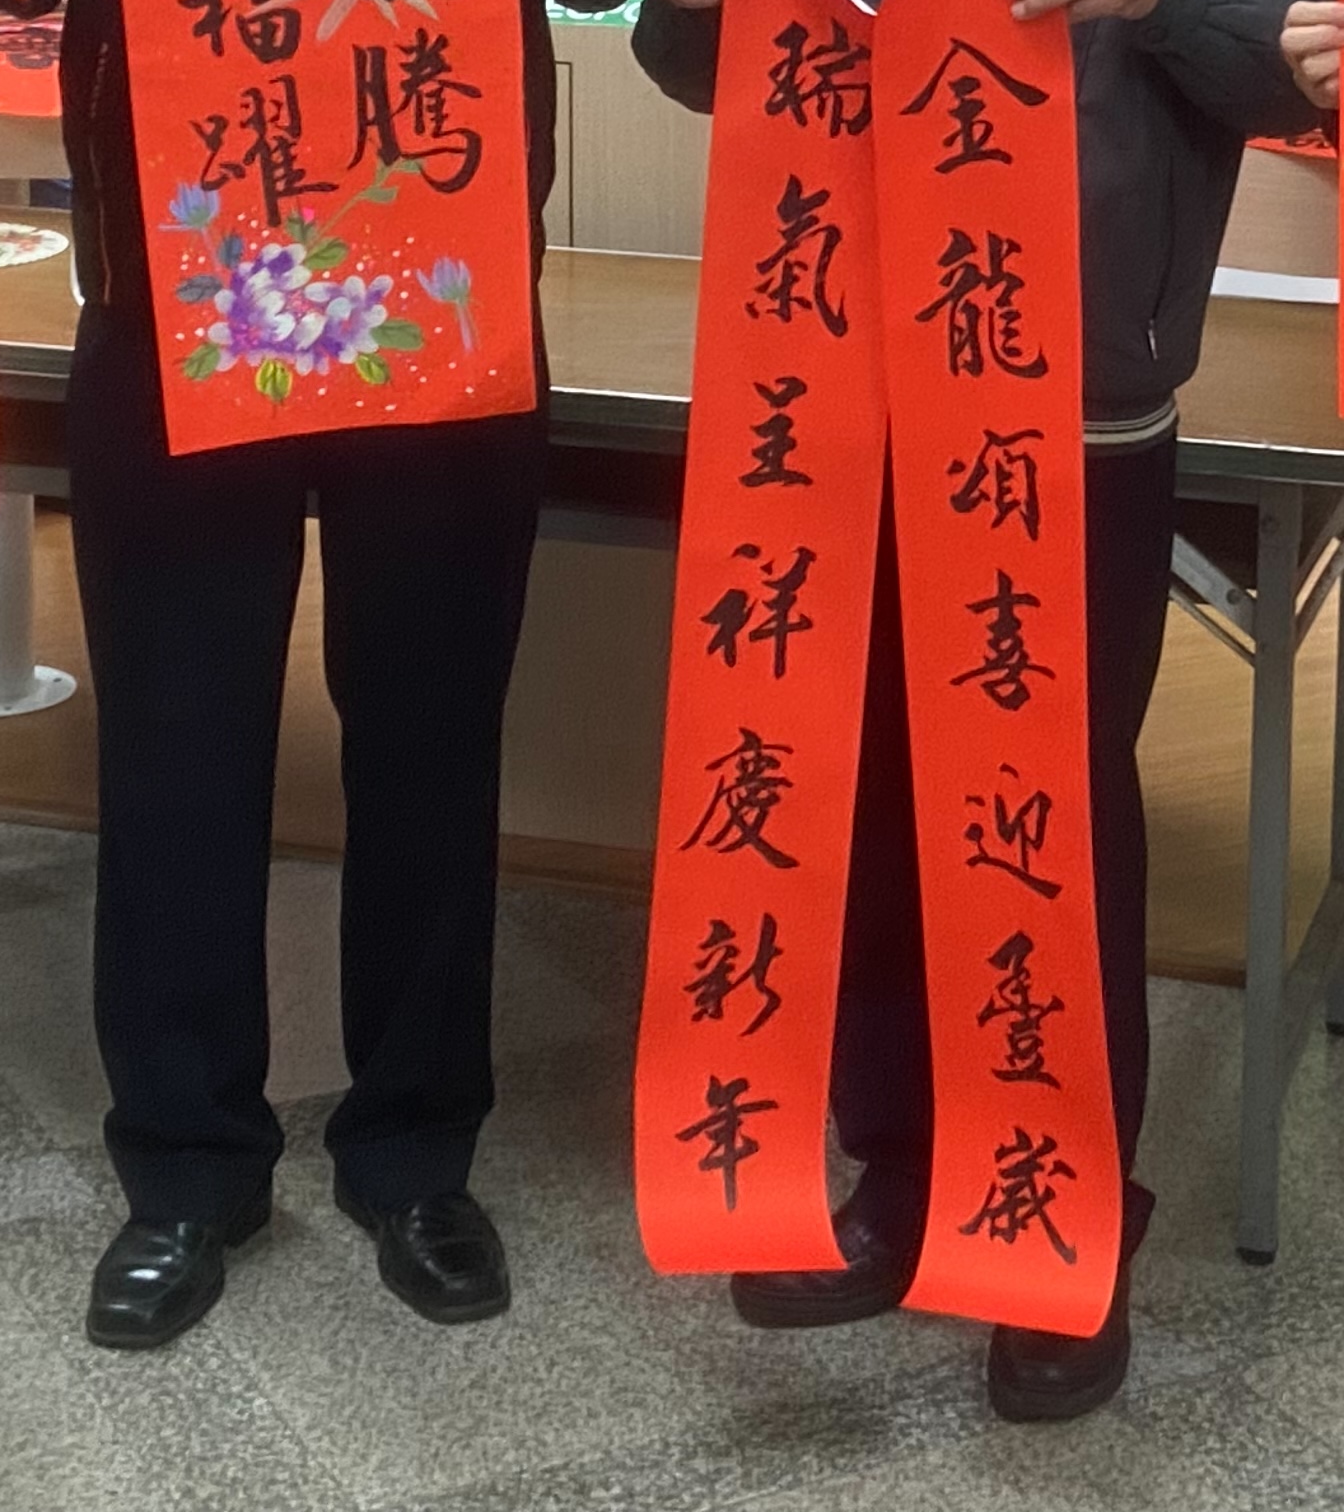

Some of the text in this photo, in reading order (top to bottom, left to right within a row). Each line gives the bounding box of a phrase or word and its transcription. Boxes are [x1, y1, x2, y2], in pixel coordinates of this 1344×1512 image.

[675, 18, 873, 1212] 瑞氣呈祥慶新年
